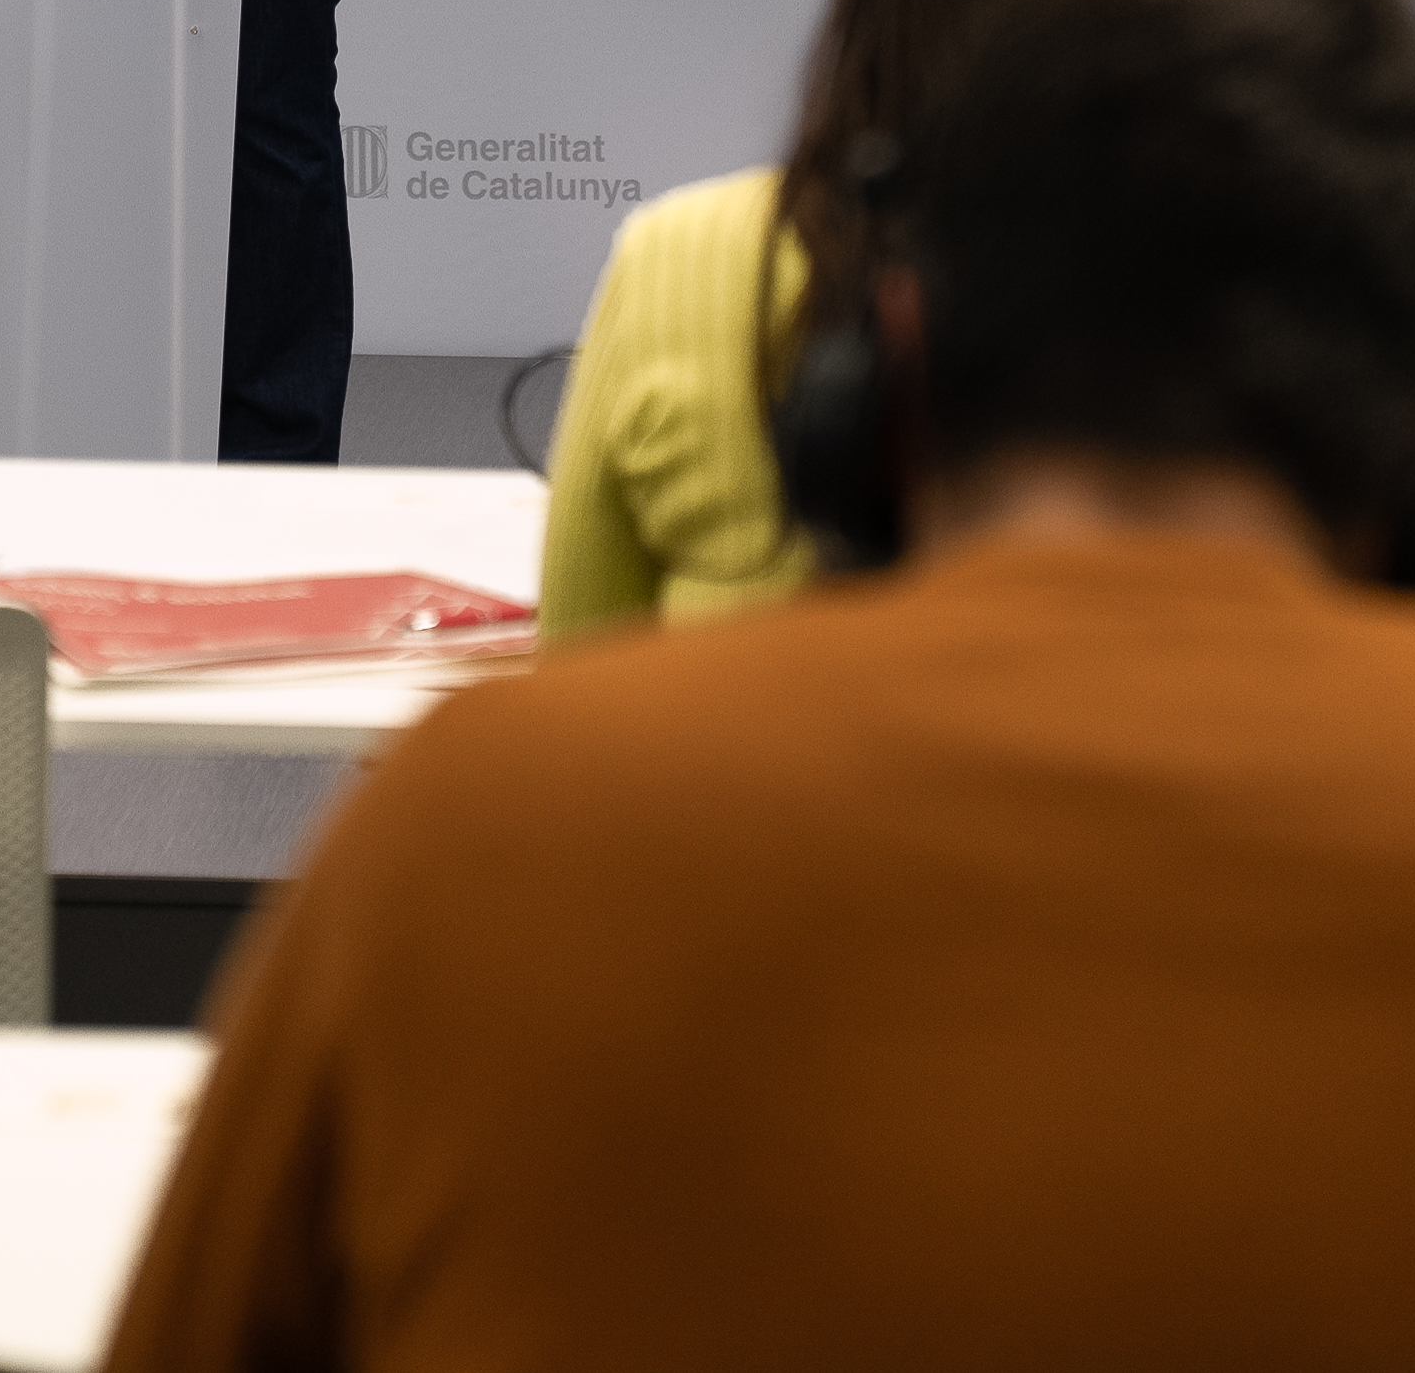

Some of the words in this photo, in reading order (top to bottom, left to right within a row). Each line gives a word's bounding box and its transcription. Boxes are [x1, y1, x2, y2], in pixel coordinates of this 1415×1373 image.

[405, 131, 605, 162] Generalitat
[406, 170, 450, 200] de
[461, 169, 641, 209] Catalunya
